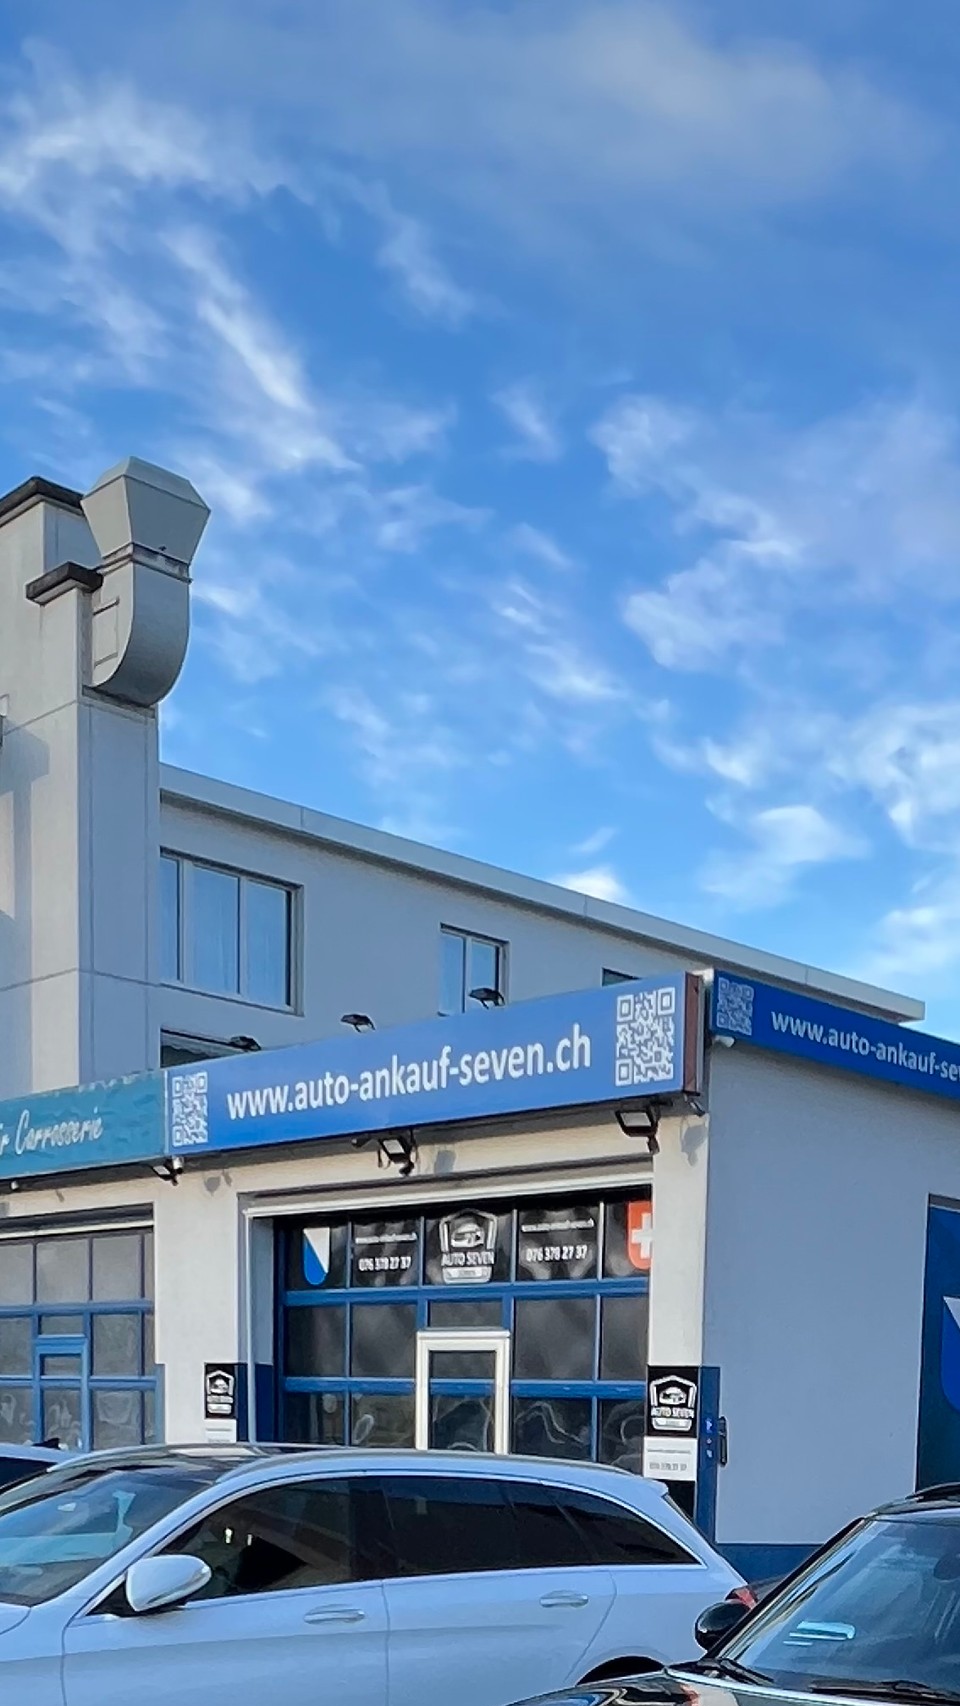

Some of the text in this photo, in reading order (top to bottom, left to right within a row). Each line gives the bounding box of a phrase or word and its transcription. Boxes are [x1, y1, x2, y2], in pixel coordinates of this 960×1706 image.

[227, 1023, 592, 1120] www.auto-ankauf-seven.ch
[15, 1106, 103, 1155] Carrosserie
[441, 1252, 494, 1266] AUTO SEVEN
